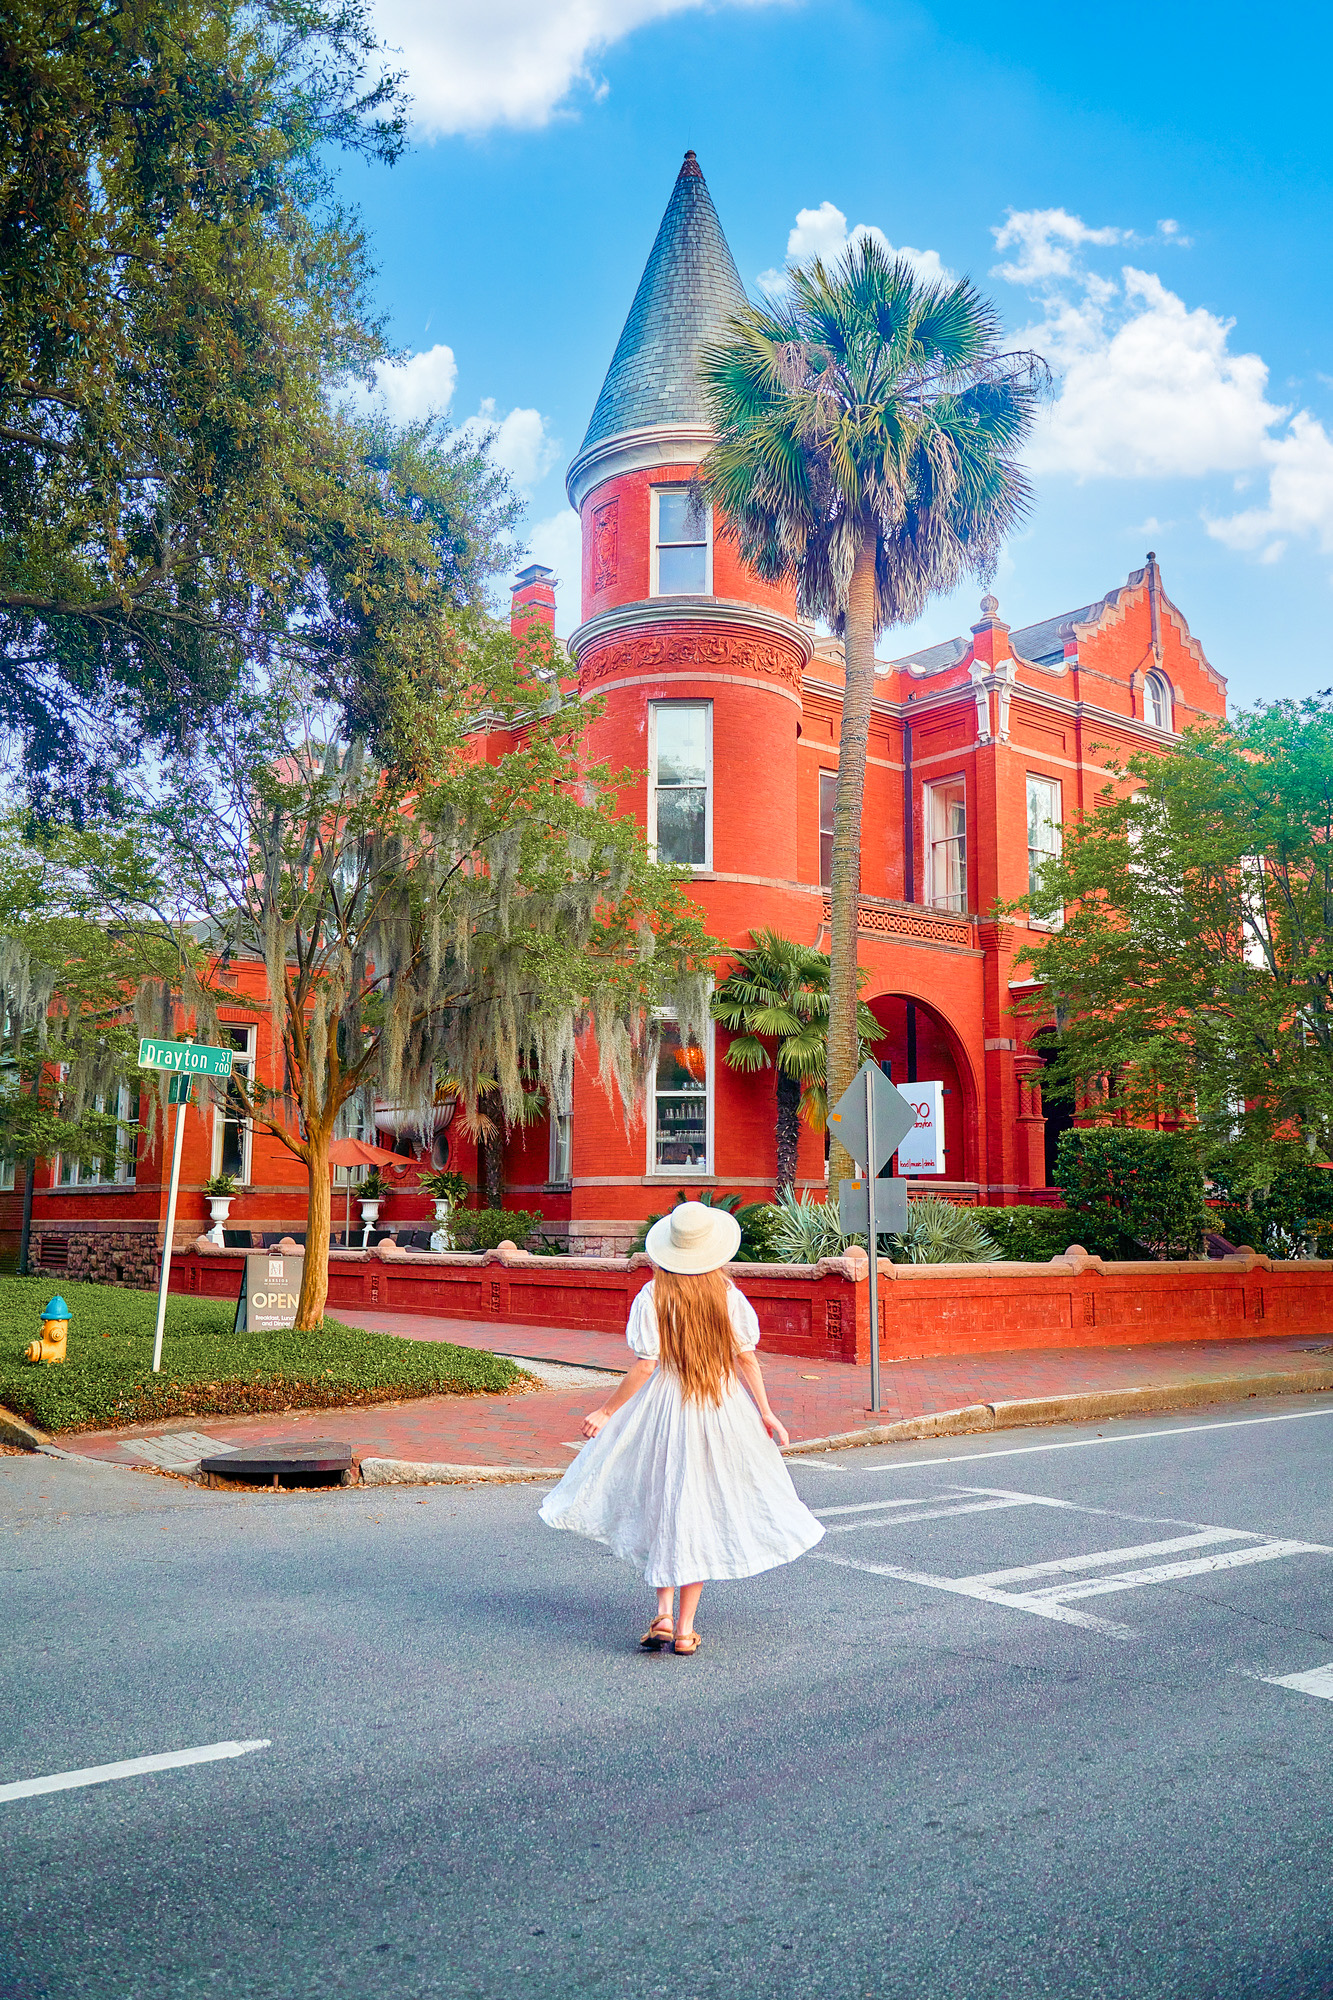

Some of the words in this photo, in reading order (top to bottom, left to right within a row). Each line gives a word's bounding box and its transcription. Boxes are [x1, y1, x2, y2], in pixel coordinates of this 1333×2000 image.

[146, 1044, 208, 1070] Drayton
[220, 1052, 231, 1062] ST
[214, 1062, 230, 1073] 700
[252, 1292, 299, 1309] OPEN
